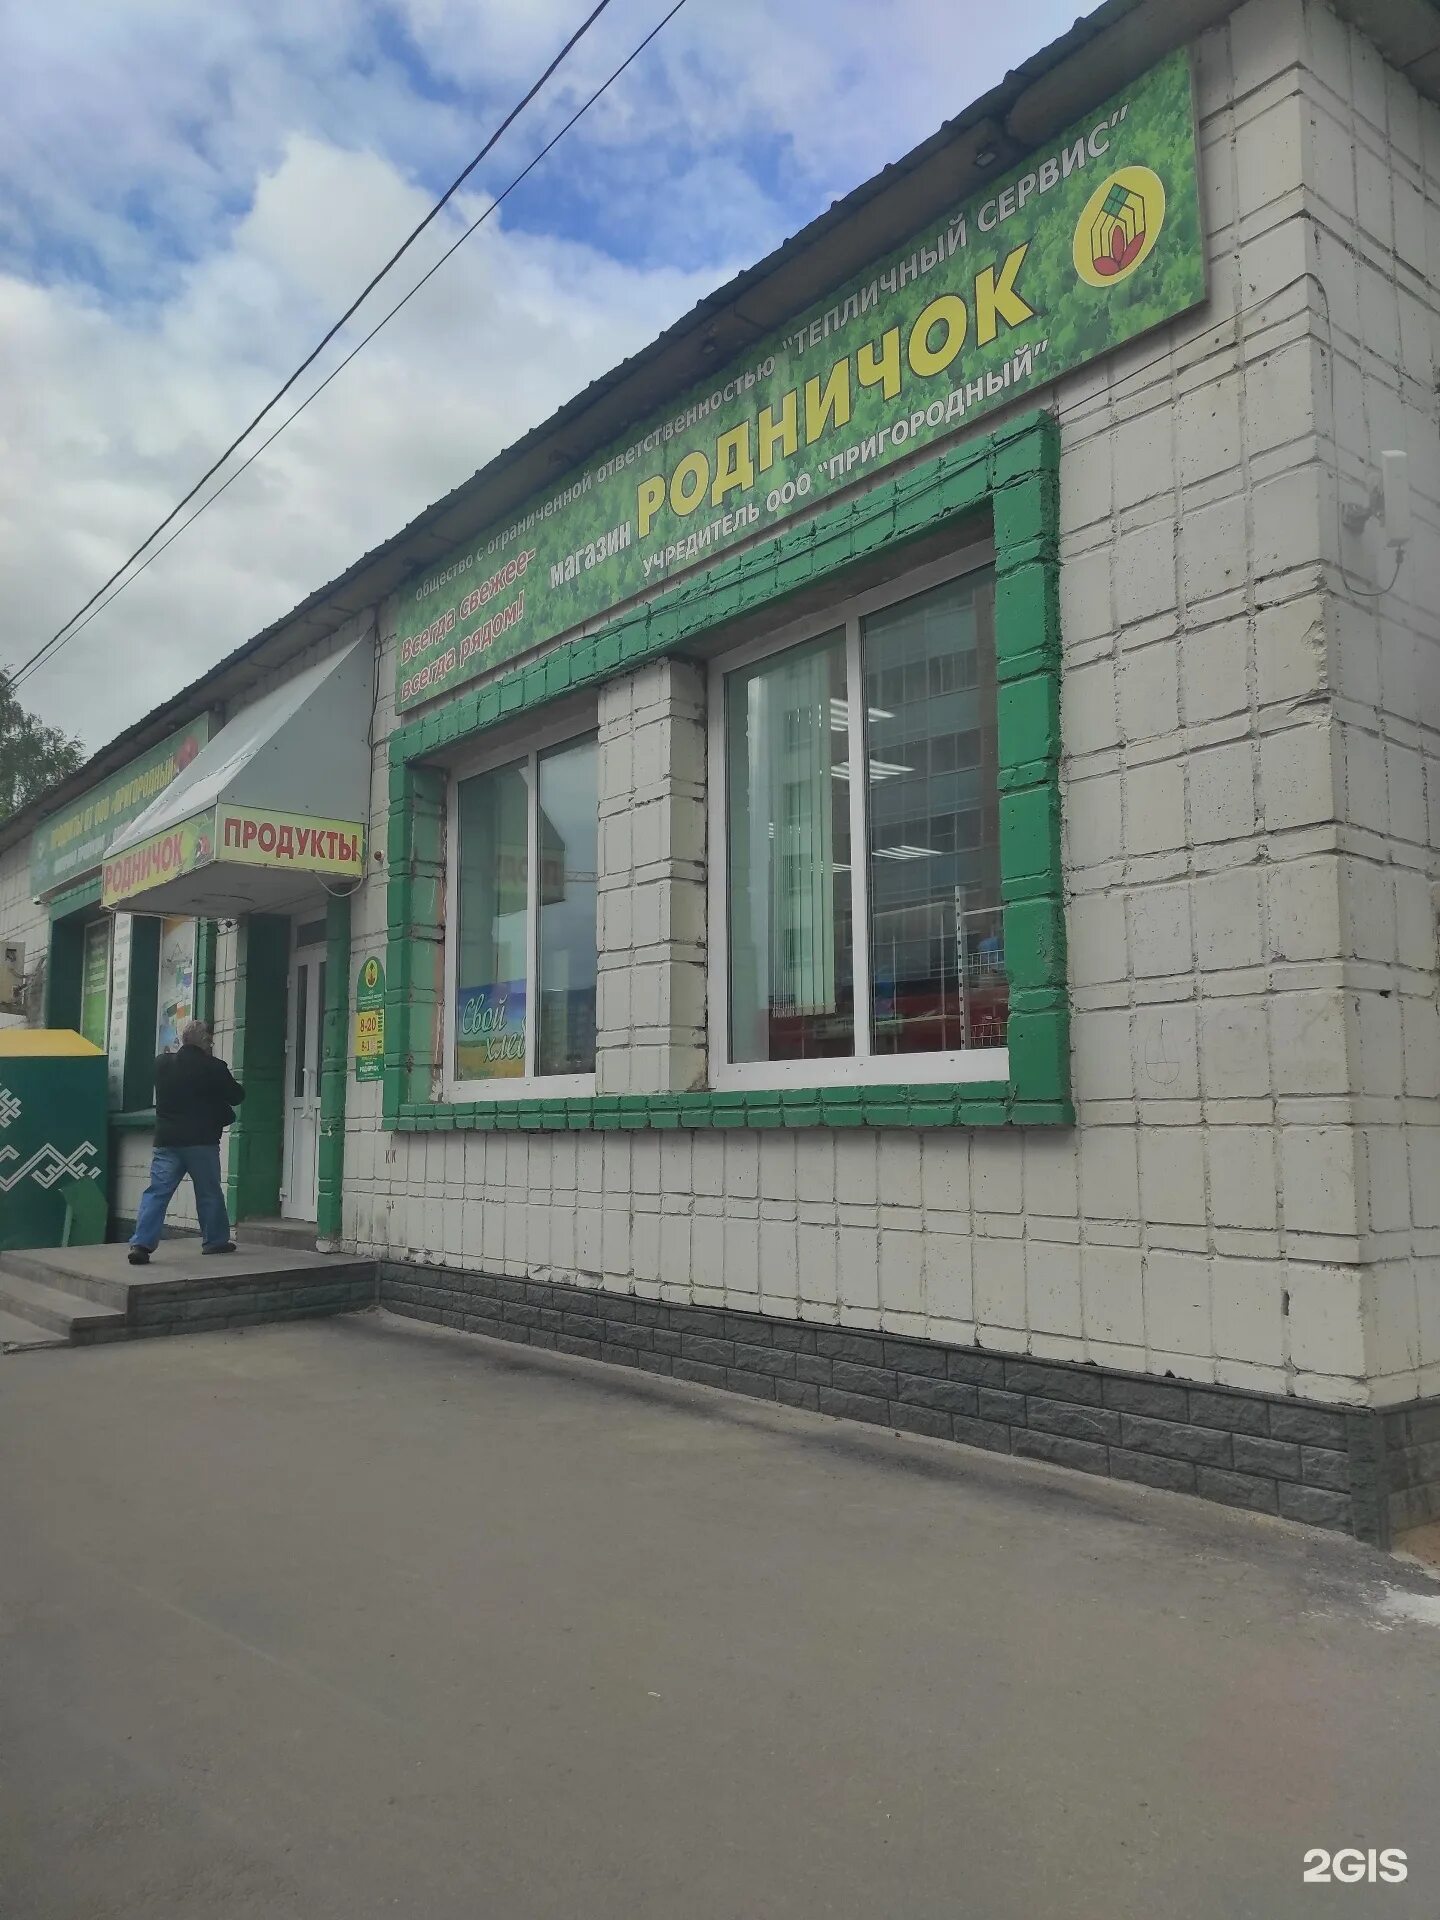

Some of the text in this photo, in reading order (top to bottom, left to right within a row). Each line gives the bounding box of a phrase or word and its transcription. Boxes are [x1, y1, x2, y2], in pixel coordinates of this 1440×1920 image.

[550, 241, 1036, 589] магазин РОДНИЧОК
[416, 554, 474, 601] общество
[476, 547, 485, 561] с
[487, 470, 592, 555] ограниченной
[597, 356, 776, 483] ответственностью
[643, 503, 760, 577] УЧРЕДИТЕЛЬ
[766, 472, 811, 512] ООО
[401, 548, 537, 667] Всегда свежее-
[401, 590, 525, 703] всегда рядом!
[104, 831, 184, 896] РОДНИЧОК
[224, 817, 358, 862] ПРОДУКТЫ
[462, 993, 508, 1034] Свой
